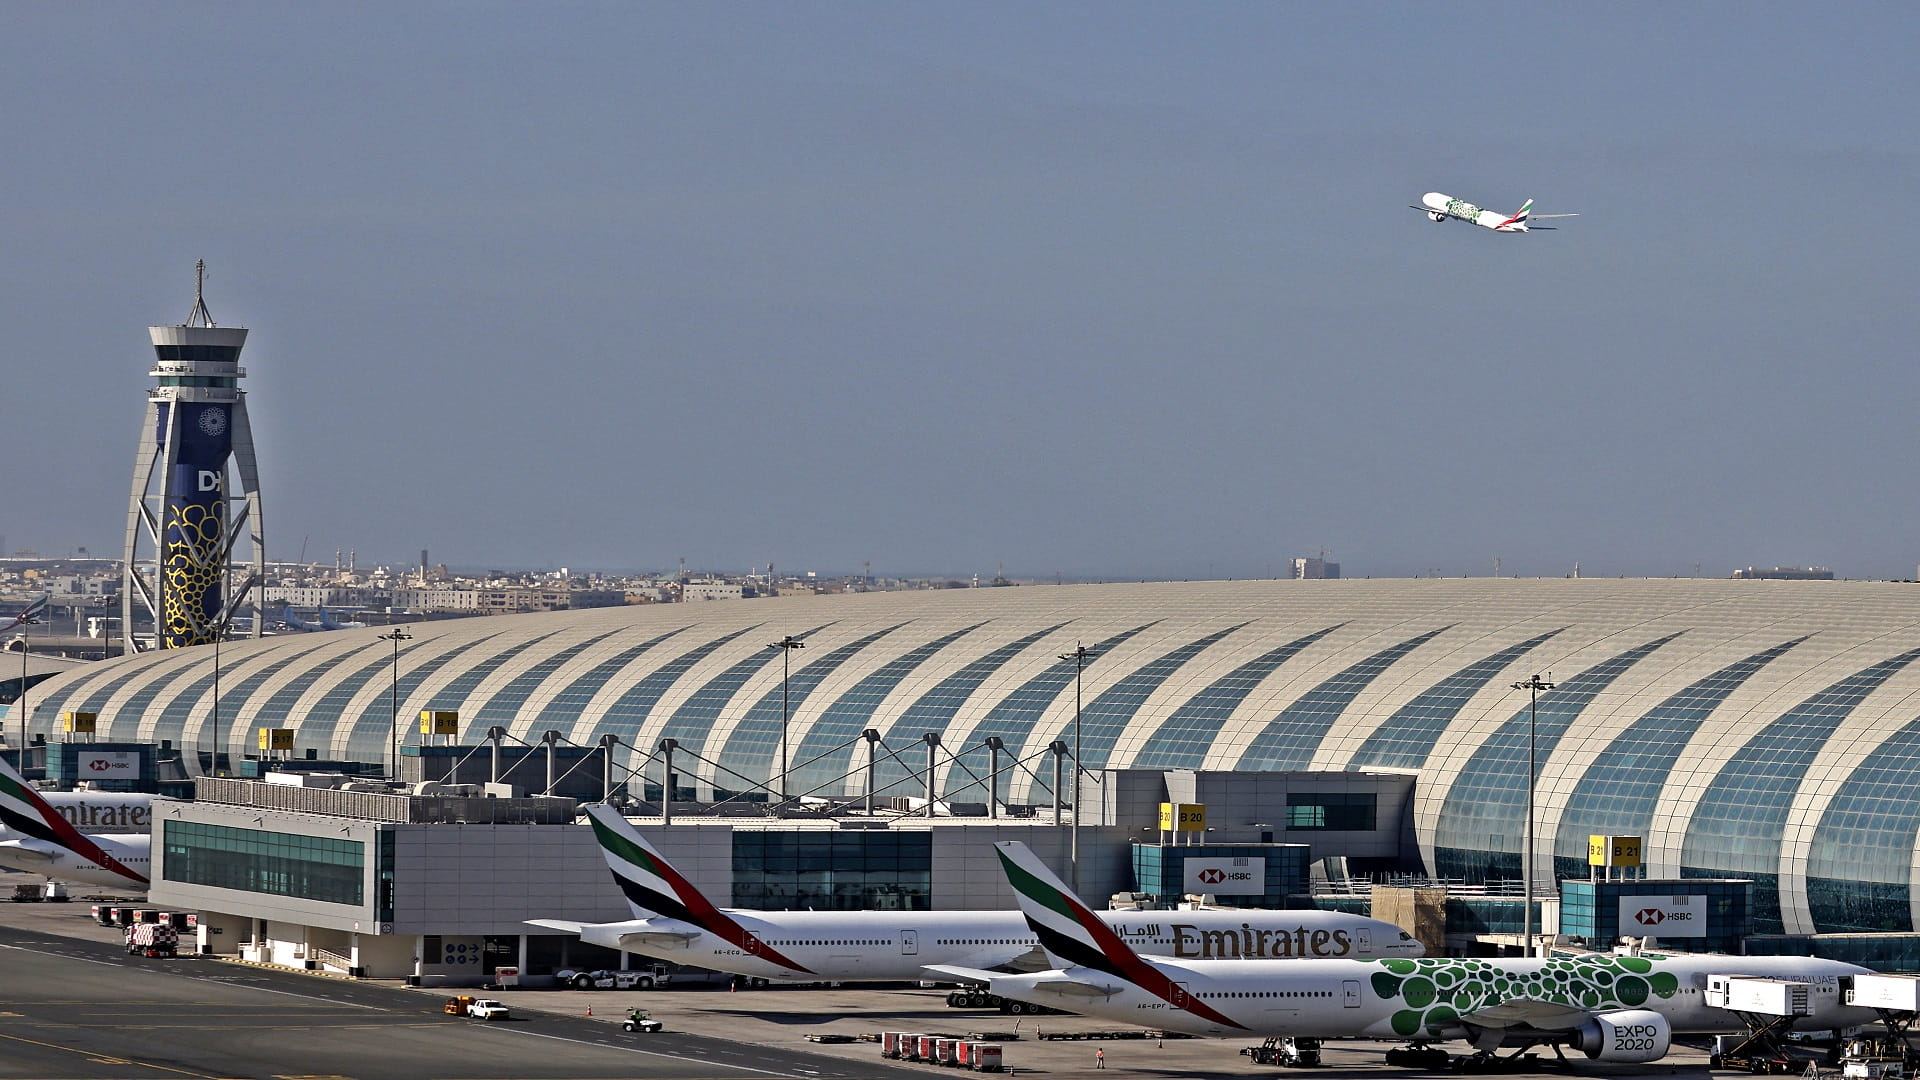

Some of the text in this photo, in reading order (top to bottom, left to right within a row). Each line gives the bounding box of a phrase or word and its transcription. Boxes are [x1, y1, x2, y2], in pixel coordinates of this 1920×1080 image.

[54, 801, 152, 825] mirate
[1164, 812, 1171, 822] 20
[1180, 812, 1202, 823] B 20
[1590, 845, 1603, 856] B 21
[1614, 846, 1638, 857] B 21
[1227, 872, 1251, 881] HSBC
[1667, 912, 1692, 921] HSBC
[1113, 924, 1160, 939] الإمارا
[1170, 923, 1350, 957] Emirates
[1614, 1025, 1657, 1038] EXPO
[1614, 1038, 1655, 1050] 2020
